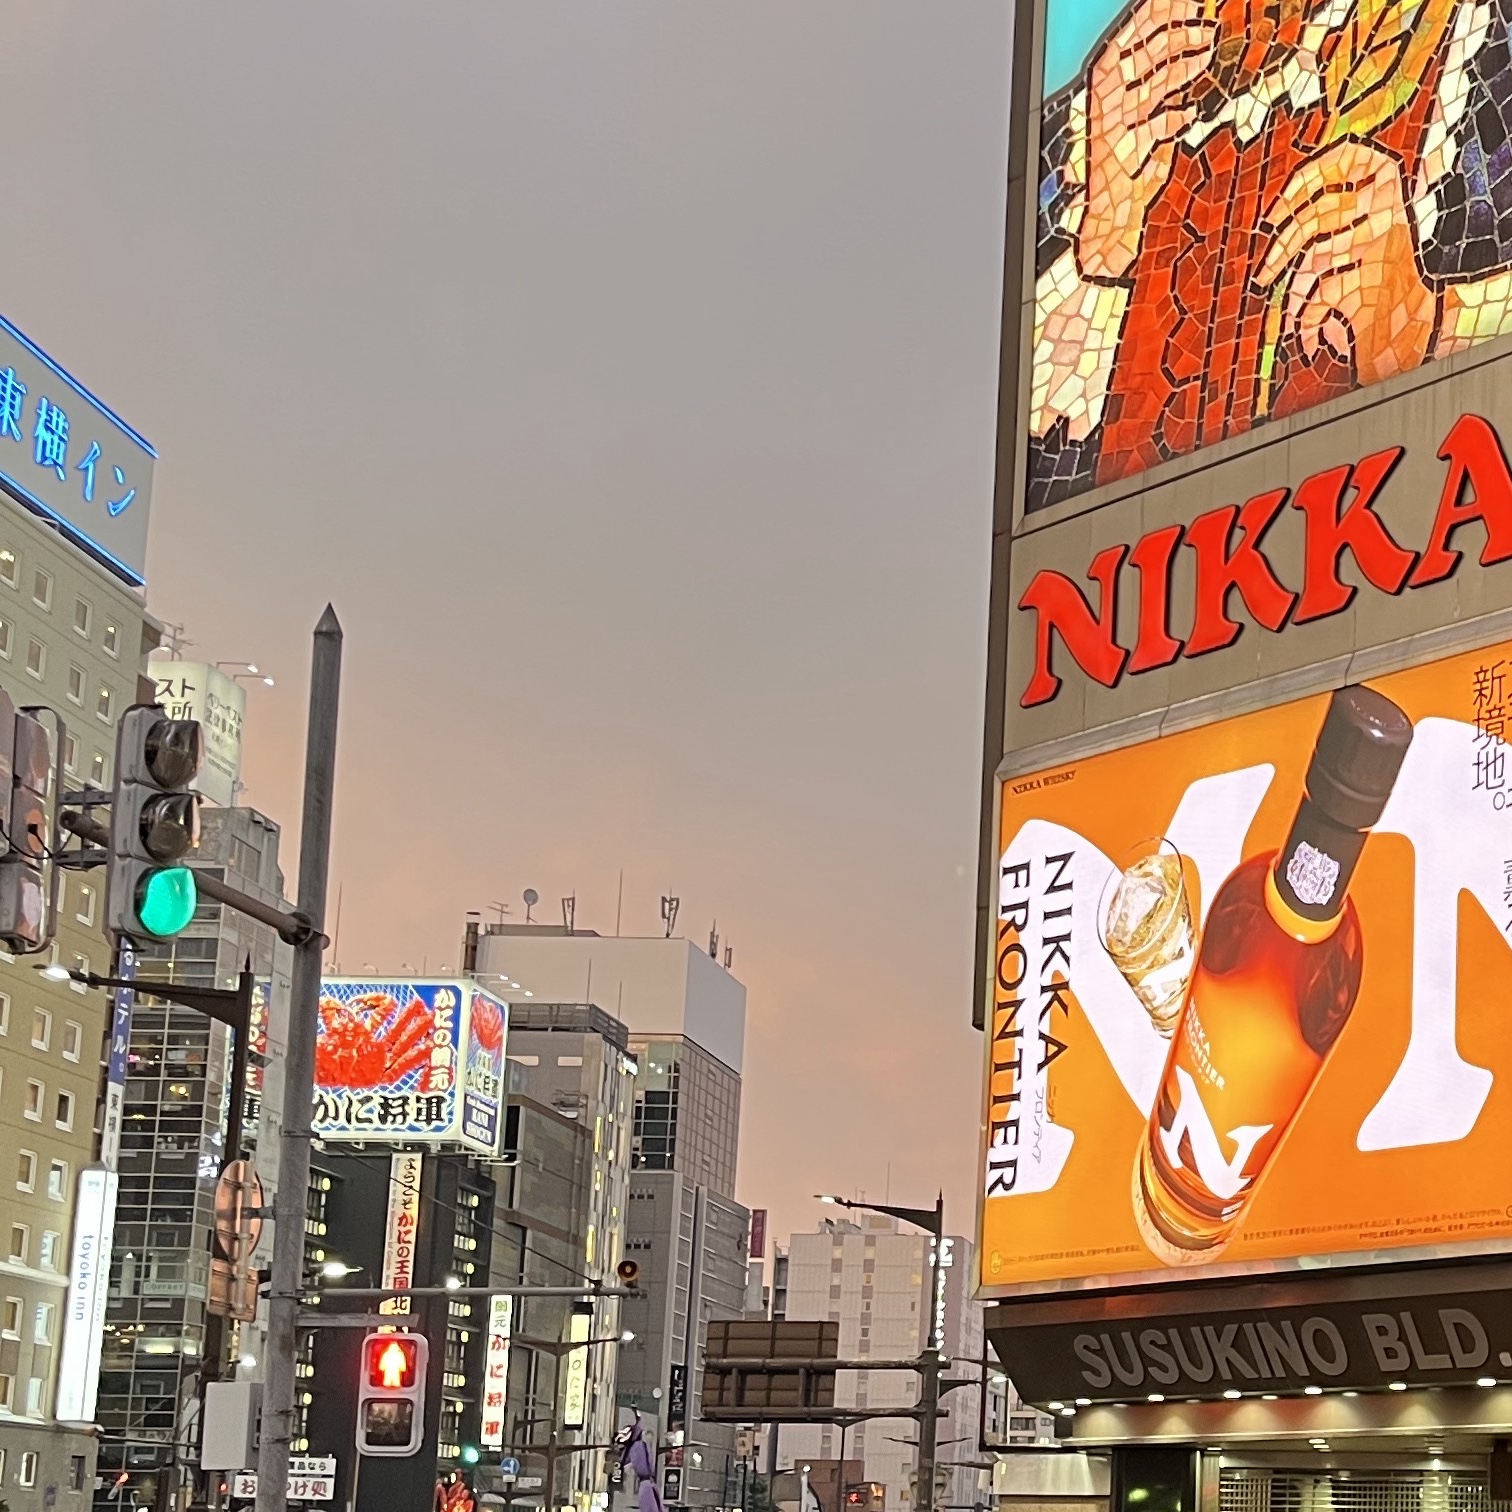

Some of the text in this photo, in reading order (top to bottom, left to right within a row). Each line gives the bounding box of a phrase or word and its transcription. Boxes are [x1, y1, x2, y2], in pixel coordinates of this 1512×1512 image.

[0, 367, 136, 516] 東横イン
[1472, 659, 1507, 811] 新境地。
[987, 858, 1031, 1198] FRONTIER
[1036, 850, 1076, 1074] NIKKA
[75, 1235, 94, 1322] toyoko inn
[1073, 1316, 1348, 1388] SUSUKINO
